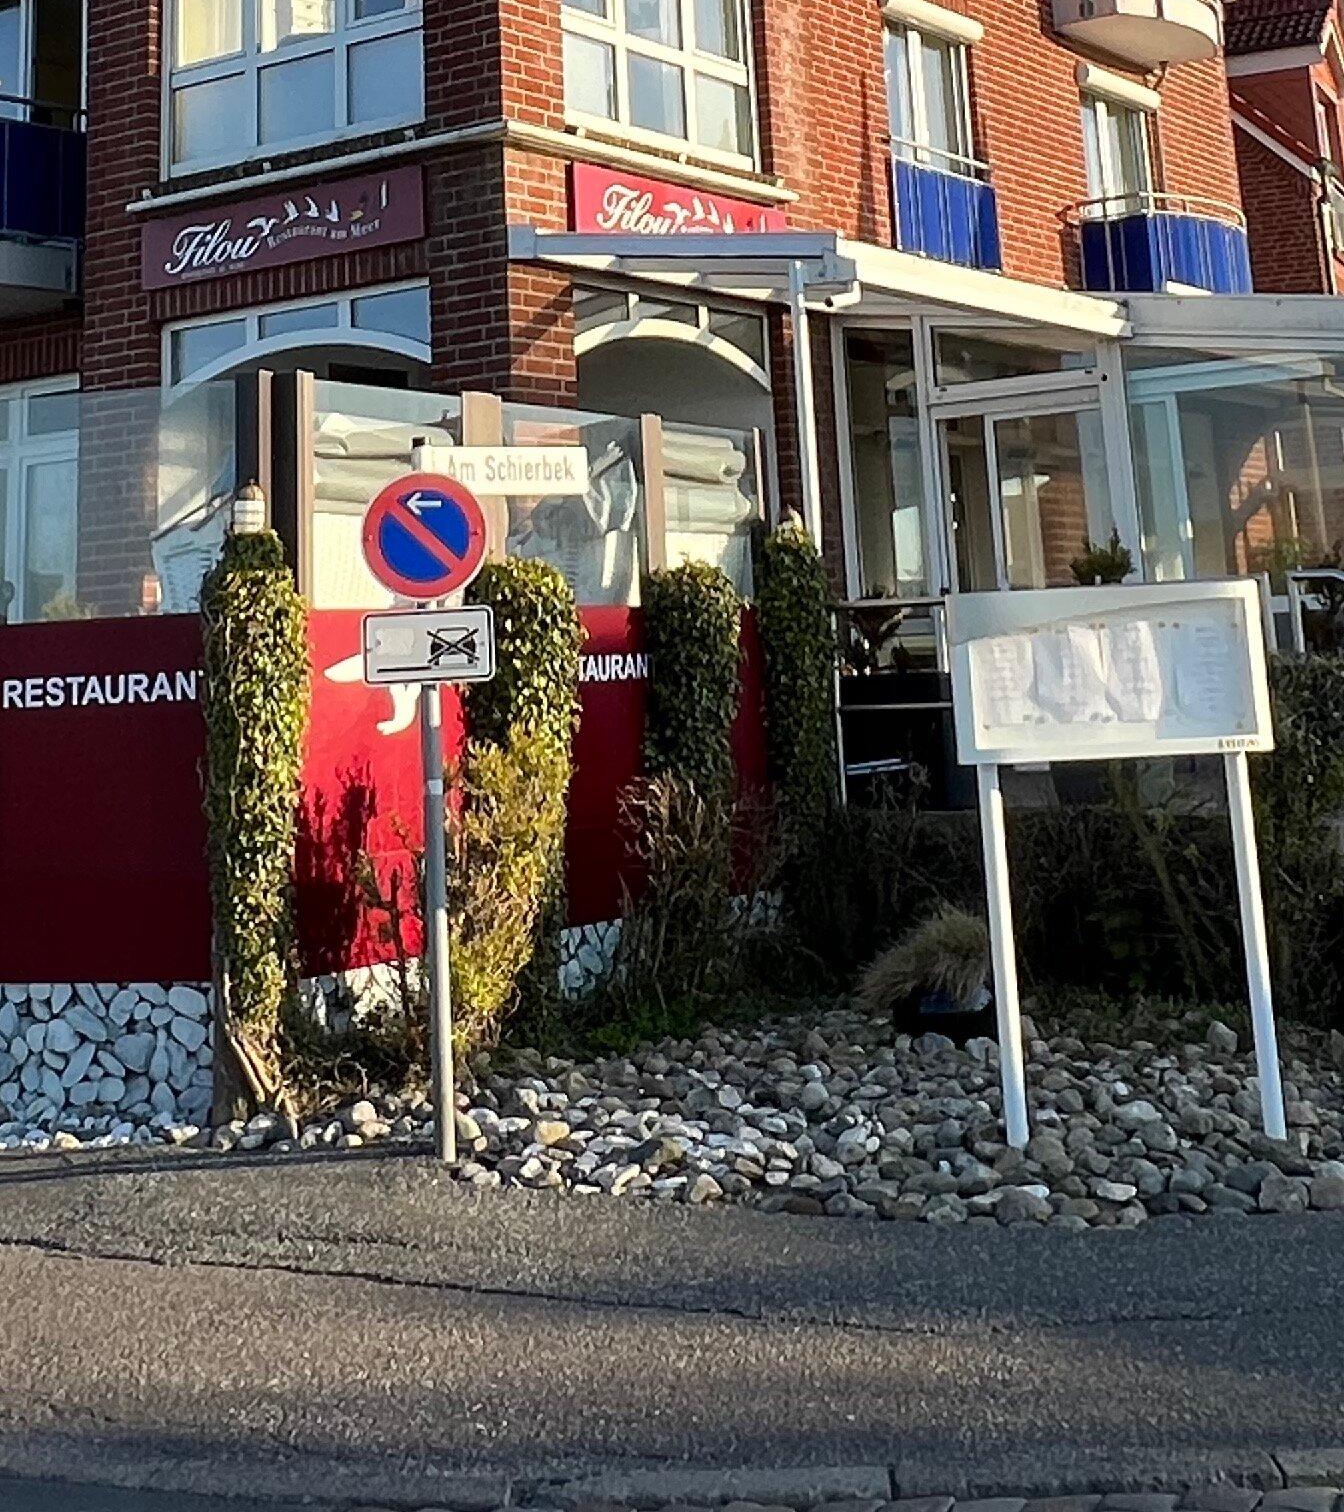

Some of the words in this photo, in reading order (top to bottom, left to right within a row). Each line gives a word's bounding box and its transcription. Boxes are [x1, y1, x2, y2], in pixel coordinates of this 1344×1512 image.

[164, 218, 262, 274] Filou
[448, 454, 475, 481] Am
[485, 454, 575, 481] Schierbek
[2, 669, 205, 709] RESTAURAN
